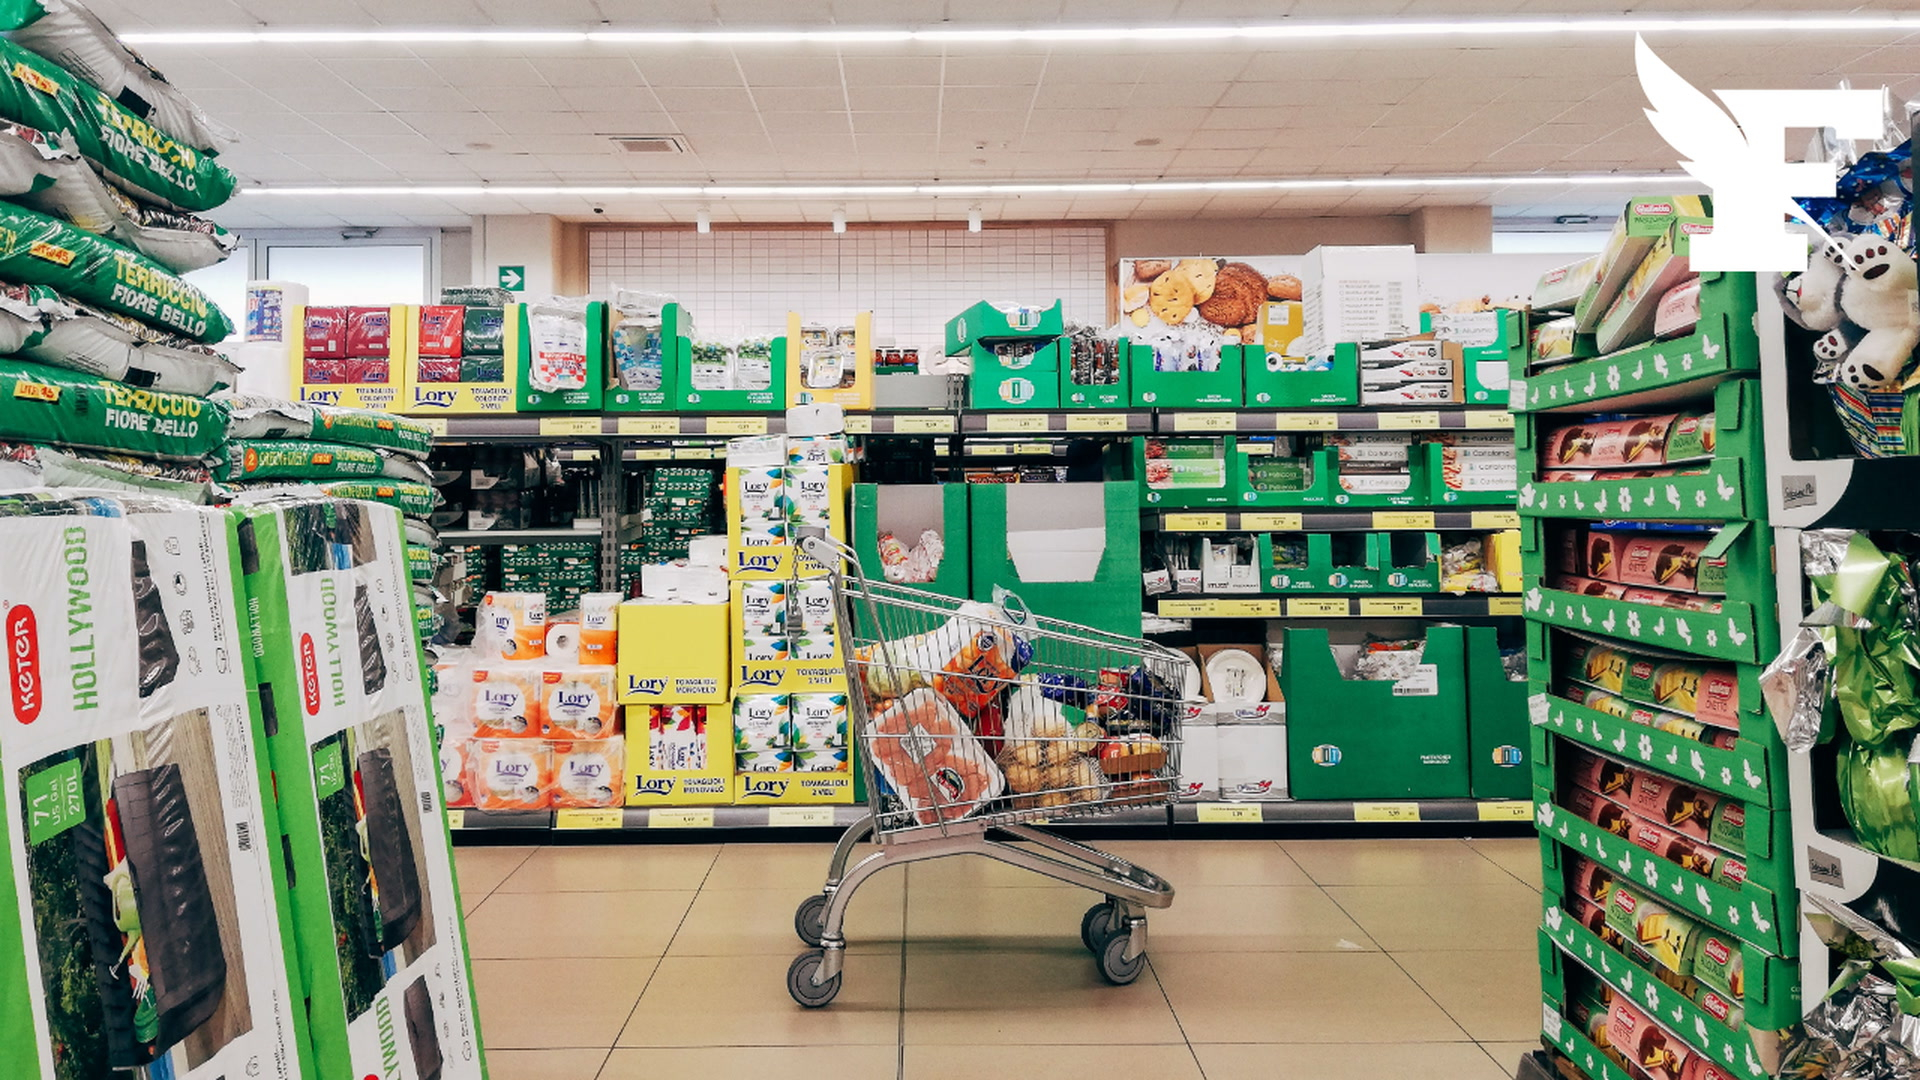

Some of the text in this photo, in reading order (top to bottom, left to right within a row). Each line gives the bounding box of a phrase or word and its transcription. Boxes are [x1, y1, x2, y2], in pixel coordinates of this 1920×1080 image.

[99, 125, 197, 192] FIORE BELLO
[114, 254, 208, 318] TERRICCIO
[110, 283, 206, 337] FIORE BELLO
[98, 380, 202, 418] TERRICCIO
[300, 386, 342, 406] Lory
[414, 386, 458, 406] Lory
[104, 407, 199, 439] FIORE BELLO
[248, 453, 256, 466] 2
[745, 481, 769, 493] Lory
[801, 481, 826, 493] Lory
[738, 551, 782, 573] Lory
[806, 596, 831, 608] Lory
[62, 525, 98, 711] HOLLYWOOD
[249, 596, 266, 659] HOLLYWOOD
[320, 577, 346, 707] HOLLYWOOD
[628, 674, 668, 695] Lory
[741, 665, 786, 685] Lory
[485, 689, 519, 707] Lory
[558, 691, 594, 708] Lory
[806, 707, 832, 719] Lory
[320, 764, 331, 786] 71
[496, 760, 532, 777] Lory
[570, 761, 604, 777] Lory
[66, 767, 81, 816] 270L
[635, 775, 676, 796] Lory
[744, 776, 789, 797] Lory
[801, 779, 848, 787] TOVAGLIOLI
[33, 794, 51, 828] 71
[49, 778, 61, 826] US Gal
